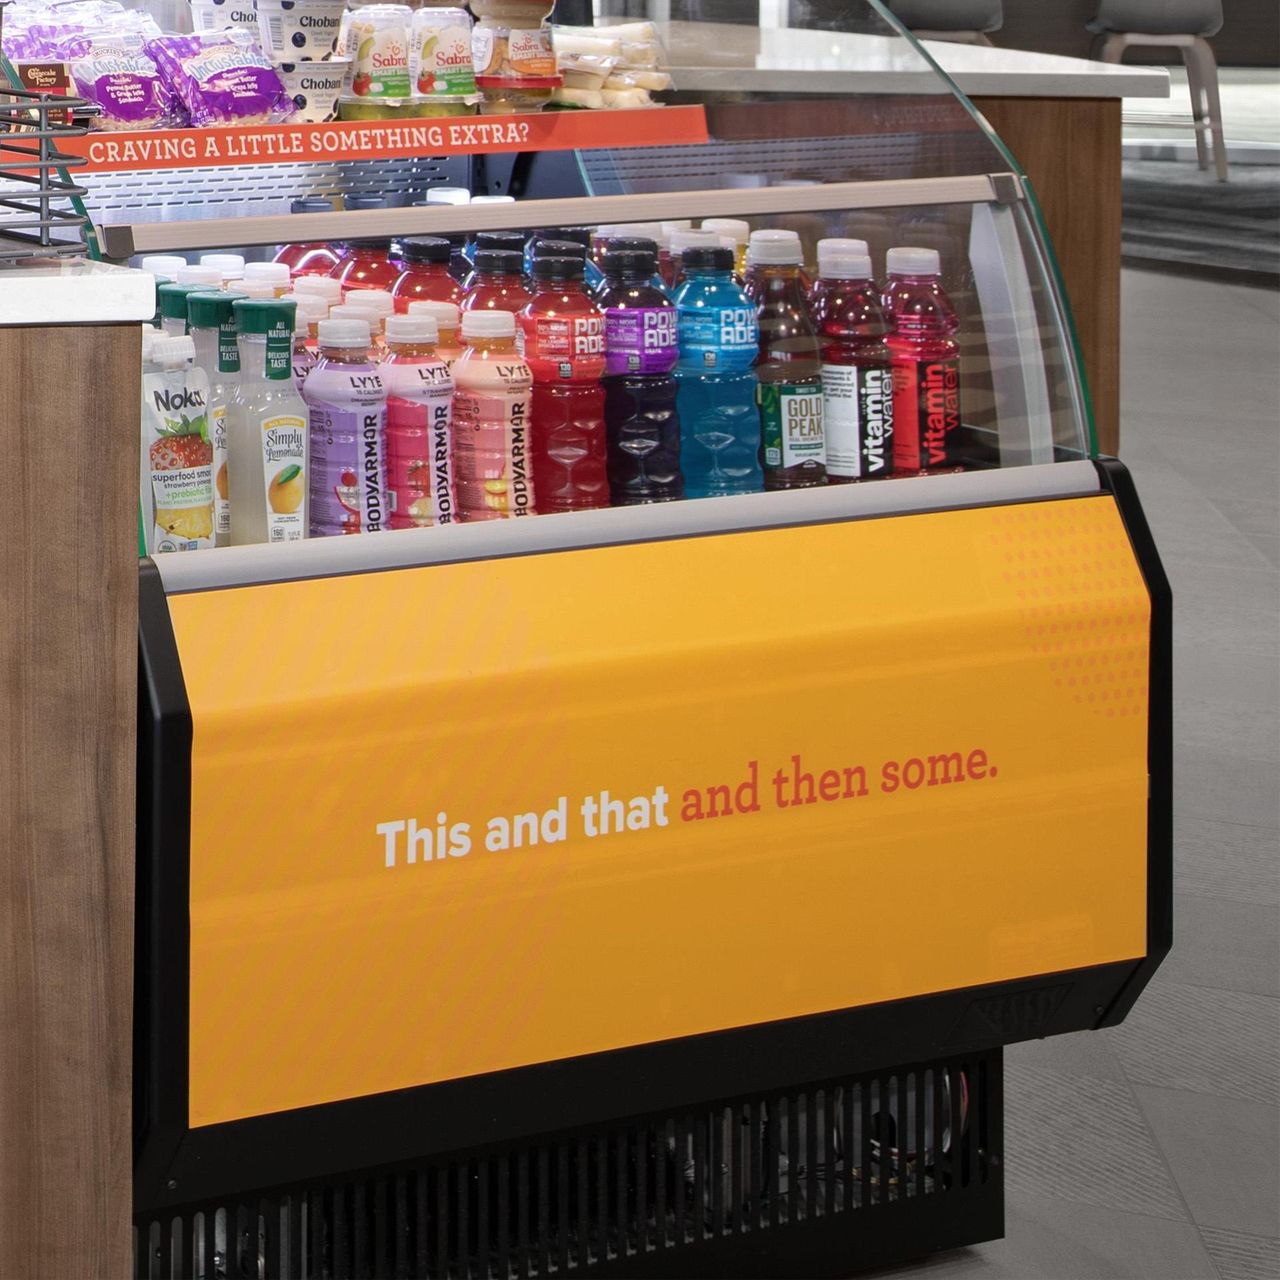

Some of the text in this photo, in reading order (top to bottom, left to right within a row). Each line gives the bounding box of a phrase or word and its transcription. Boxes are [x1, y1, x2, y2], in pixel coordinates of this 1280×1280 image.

[89, 123, 529, 163] CRAVING A LITTLE SOMETHING EXTRA?
[276, 321, 285, 330] ALL
[575, 336, 605, 354] ADE
[644, 329, 677, 347] ADE
[268, 350, 289, 359] DELICIOUS
[270, 359, 287, 368] TASTE
[418, 366, 450, 380] LYTE
[497, 365, 530, 378] LYTE
[560, 363, 571, 371] 130
[350, 376, 383, 388] LYTE
[788, 398, 822, 416] GOLD
[882, 370, 894, 438] water
[944, 366, 959, 431] water
[861, 370, 885, 472] vitamin
[922, 364, 946, 465] vitamin
[789, 419, 823, 437] PEAK
[267, 430, 303, 449] Simply
[265, 447, 304, 463] Lemonade
[512, 401, 529, 518] BODYARMOR
[364, 413, 382, 534] BODYARMOR
[434, 405, 451, 525] BODYARMOR
[152, 472, 196, 483] superfood
[164, 481, 195, 490] strawberry
[376, 747, 998, 868] This and that and then some.
